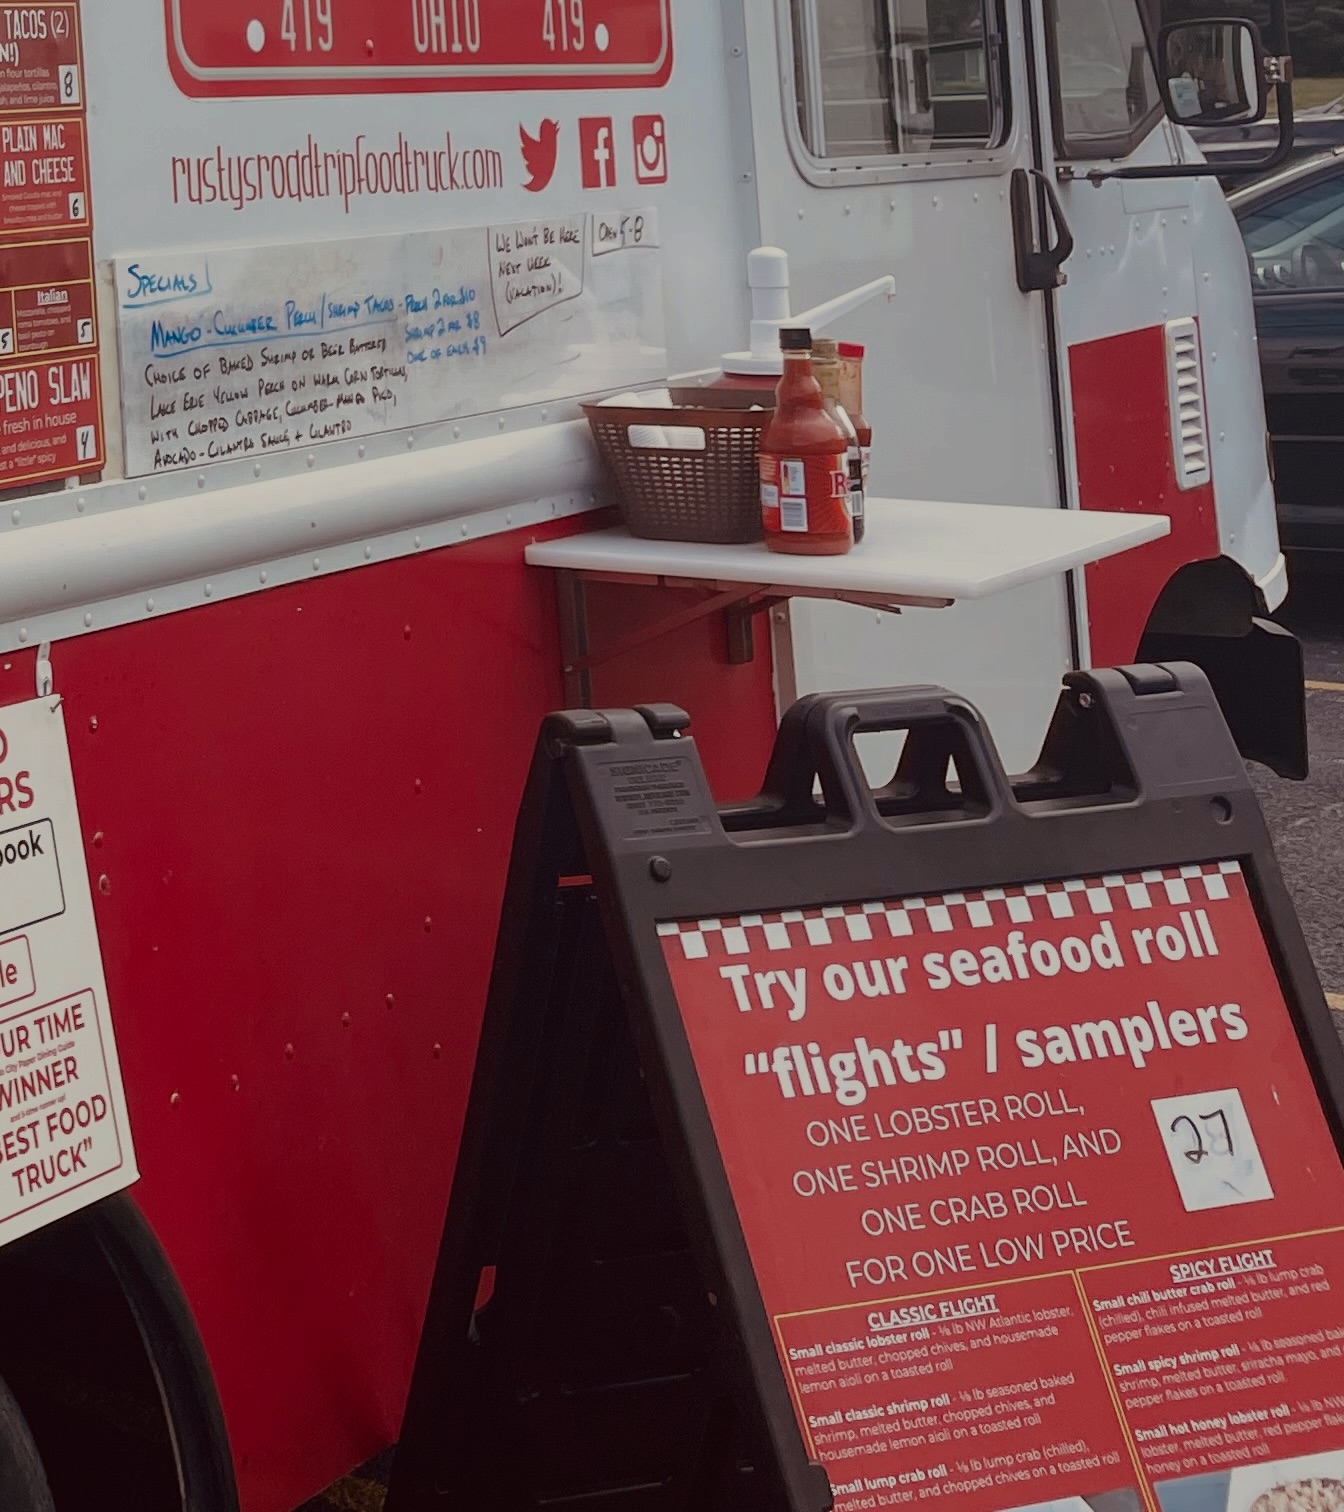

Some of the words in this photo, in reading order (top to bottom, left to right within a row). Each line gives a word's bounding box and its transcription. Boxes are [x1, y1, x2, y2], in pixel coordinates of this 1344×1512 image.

[170, 131, 504, 214] rustysroadtripfoodtruck.com
[126, 260, 200, 299] SPECIALS
[47, 361, 91, 406] SLAW
[718, 963, 807, 1022] Try
[822, 955, 909, 1002] our
[922, 919, 1125, 990] seafood
[1131, 908, 1220, 965] roll
[32, 1002, 86, 1045] TIME
[744, 1028, 963, 1107] “flights”
[985, 1023, 998, 1074] /
[1015, 1000, 1249, 1069] samplers
[805, 1114, 872, 1148] ONE
[873, 1098, 1001, 1139] LOBSTER
[1003, 1088, 1085, 1121] ROLL,
[1168, 1108, 1235, 1164] 27
